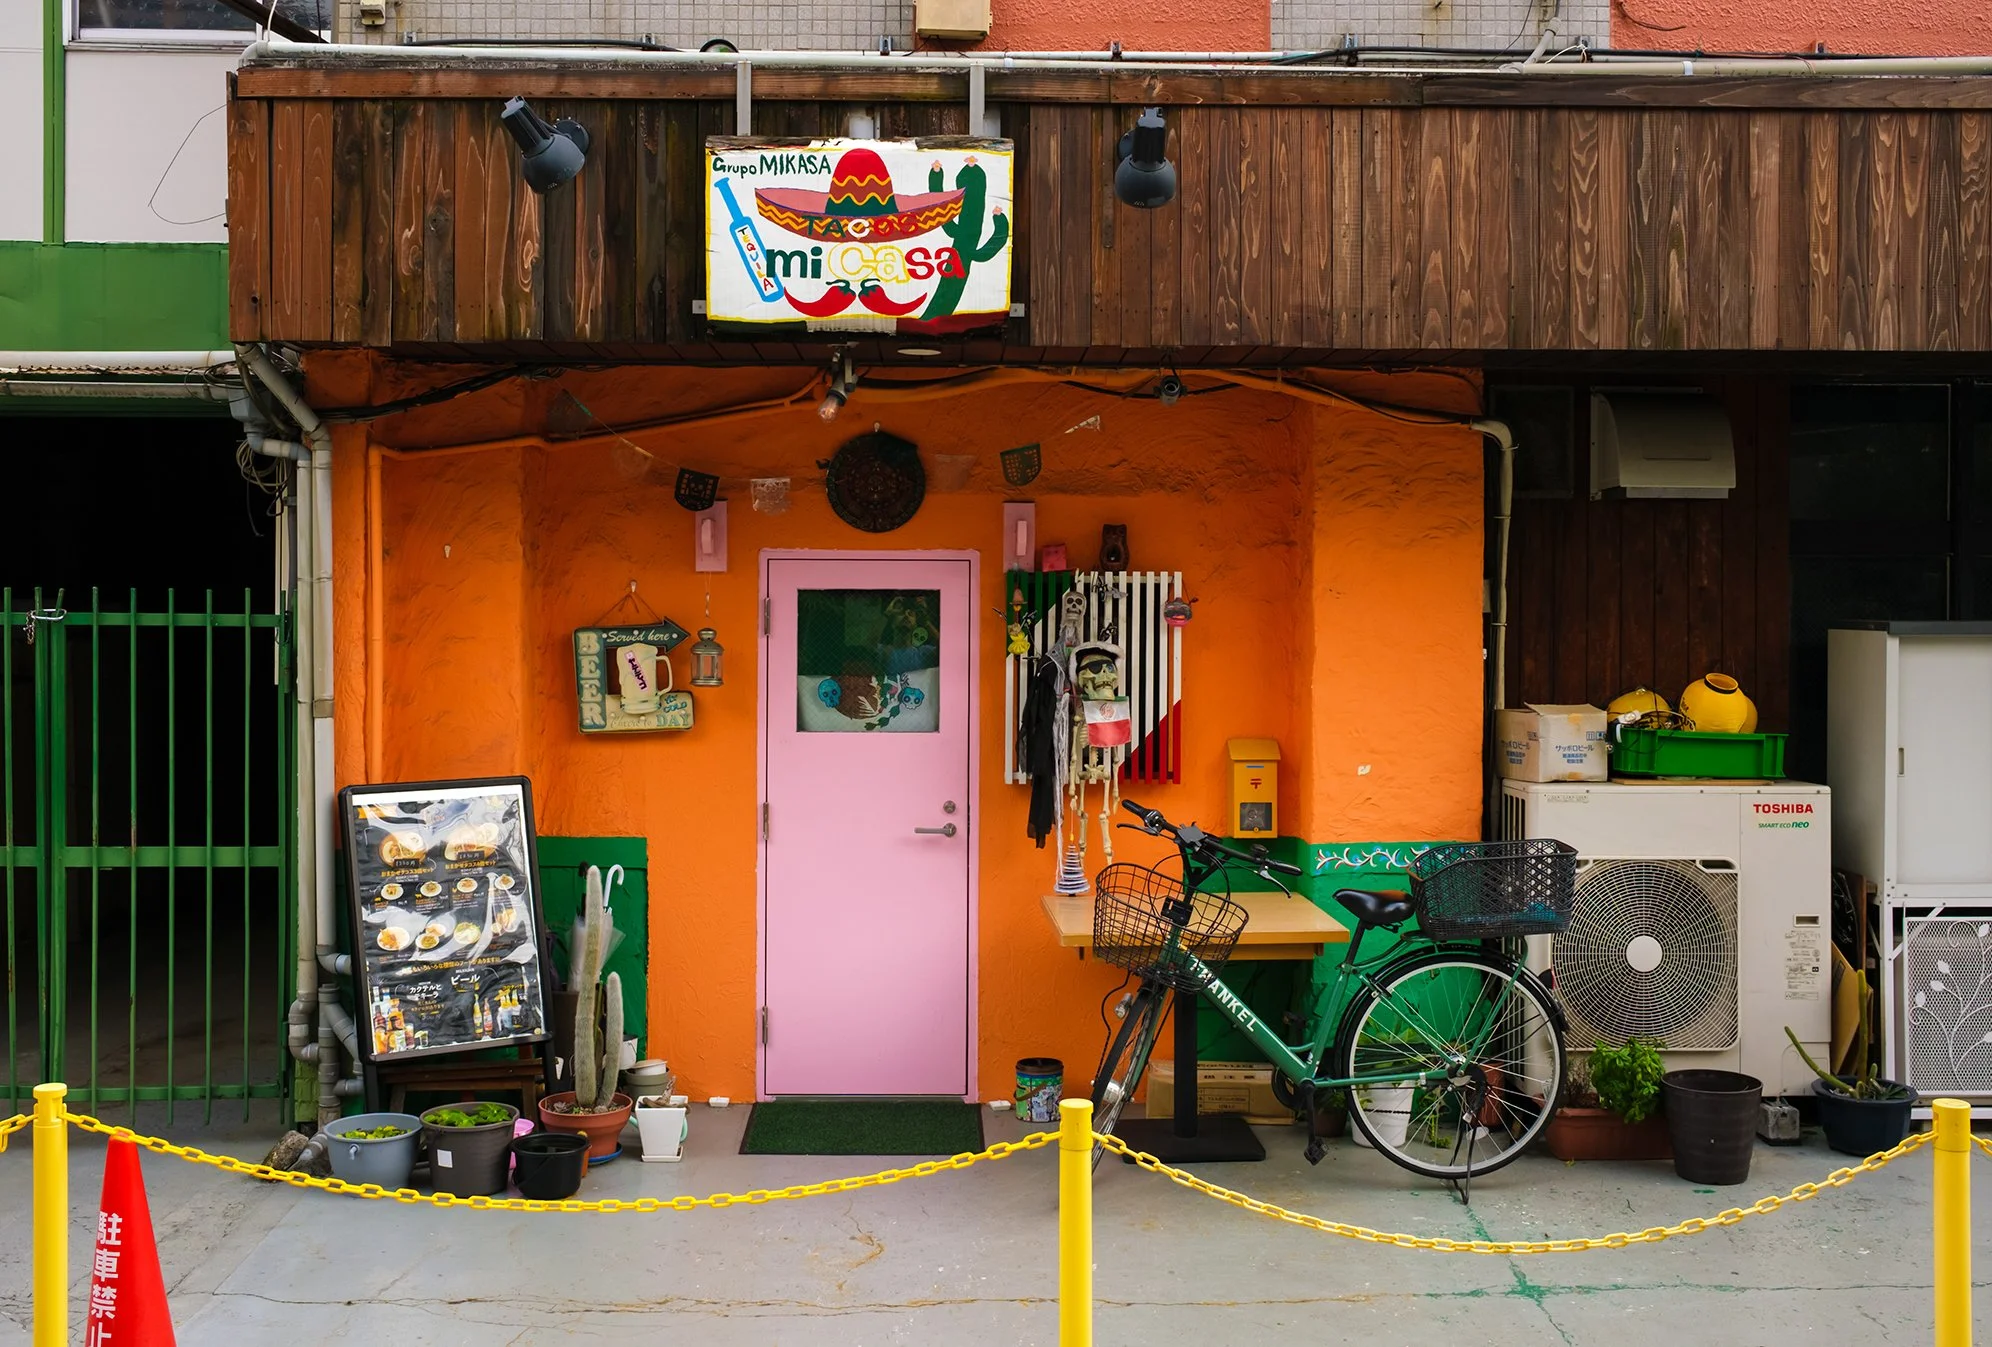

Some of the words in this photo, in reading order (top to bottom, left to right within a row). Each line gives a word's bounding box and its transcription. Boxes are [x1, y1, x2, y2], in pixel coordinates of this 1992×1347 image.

[712, 157, 757, 179] Grupo
[760, 153, 832, 176] MIKASA
[801, 212, 921, 239] TACOS
[737, 226, 774, 292] TEQUILA
[766, 246, 822, 280] mi
[606, 629, 645, 643] Served
[647, 629, 671, 642] here
[577, 631, 605, 727] BEER
[656, 714, 689, 727] DAY
[1753, 804, 1814, 814] TOSHIBA
[1791, 821, 1810, 829] neo
[409, 982, 442, 995] カクテルと
[451, 972, 481, 986] ビール
[88, 1211, 123, 1347] 駐車禁止
